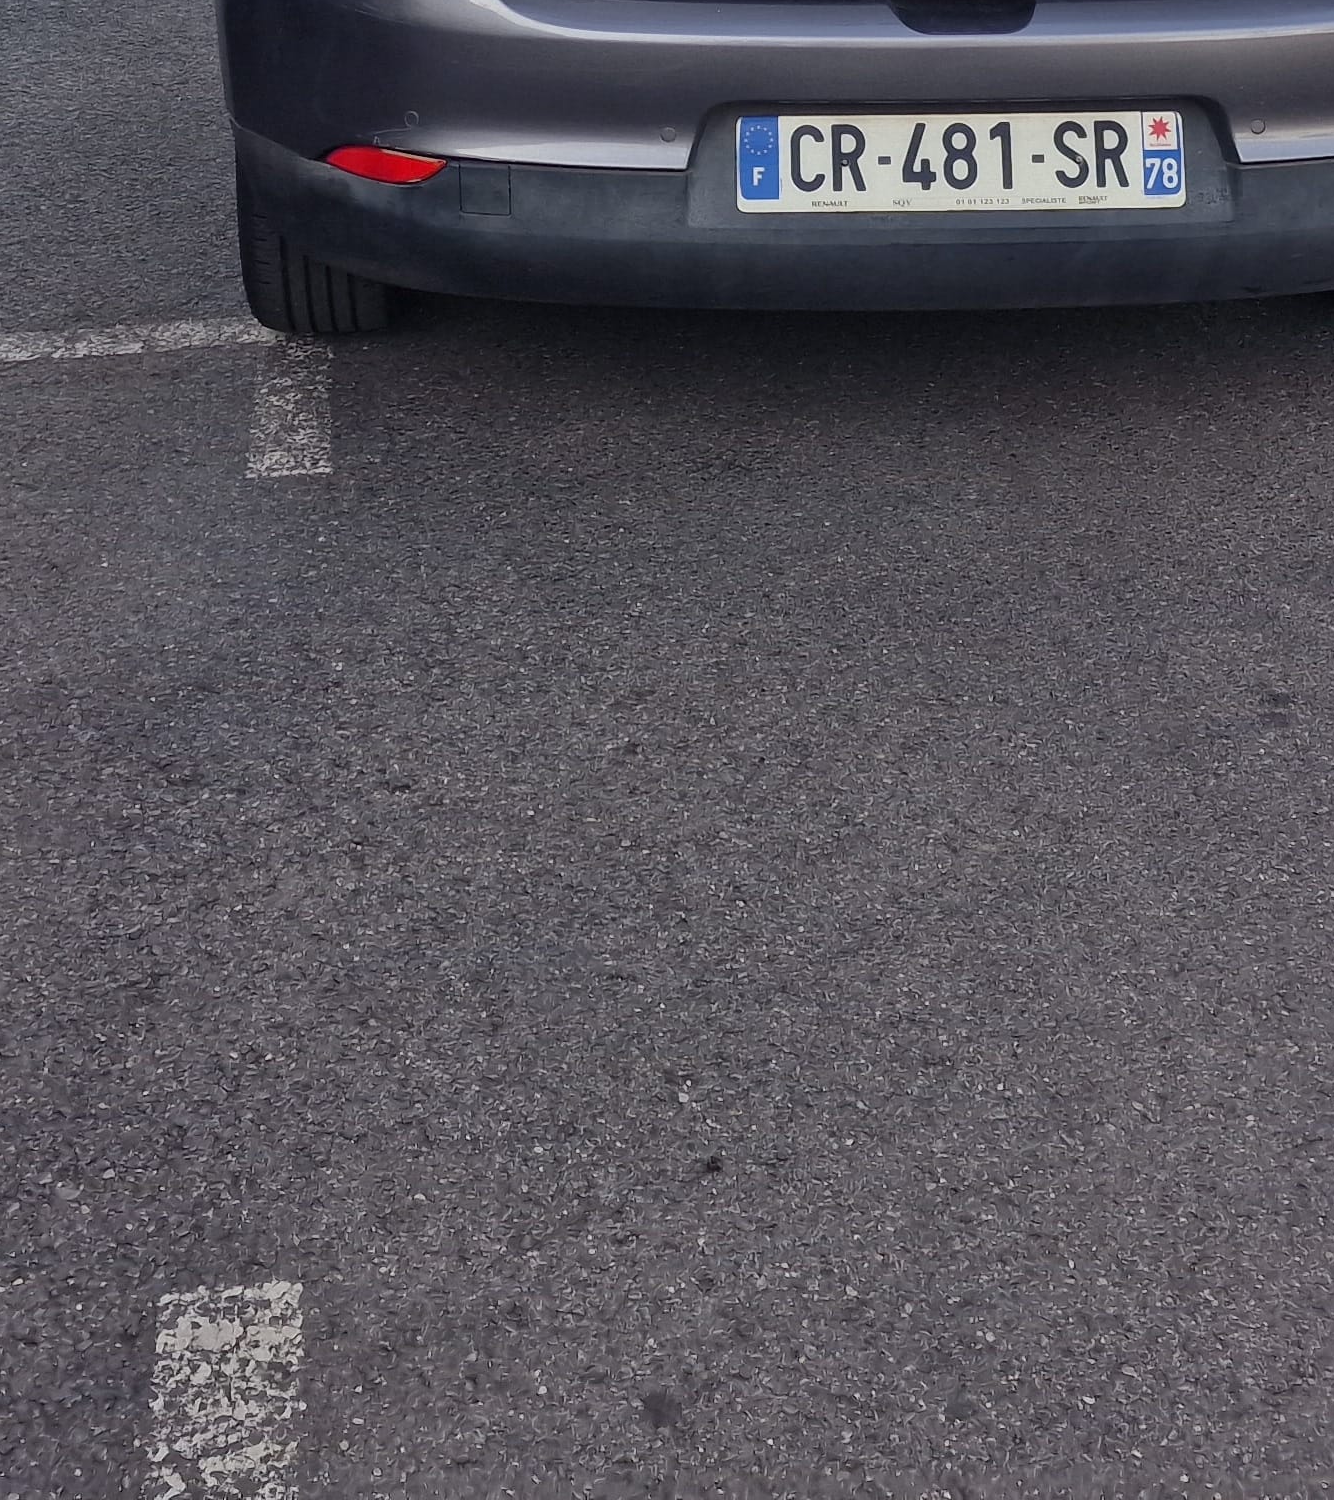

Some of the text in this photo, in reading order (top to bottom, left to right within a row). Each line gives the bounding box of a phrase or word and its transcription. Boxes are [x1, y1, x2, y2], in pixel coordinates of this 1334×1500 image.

[789, 120, 1129, 193] CR-481-SR
[753, 167, 765, 186] F
[1145, 157, 1178, 189] 78
